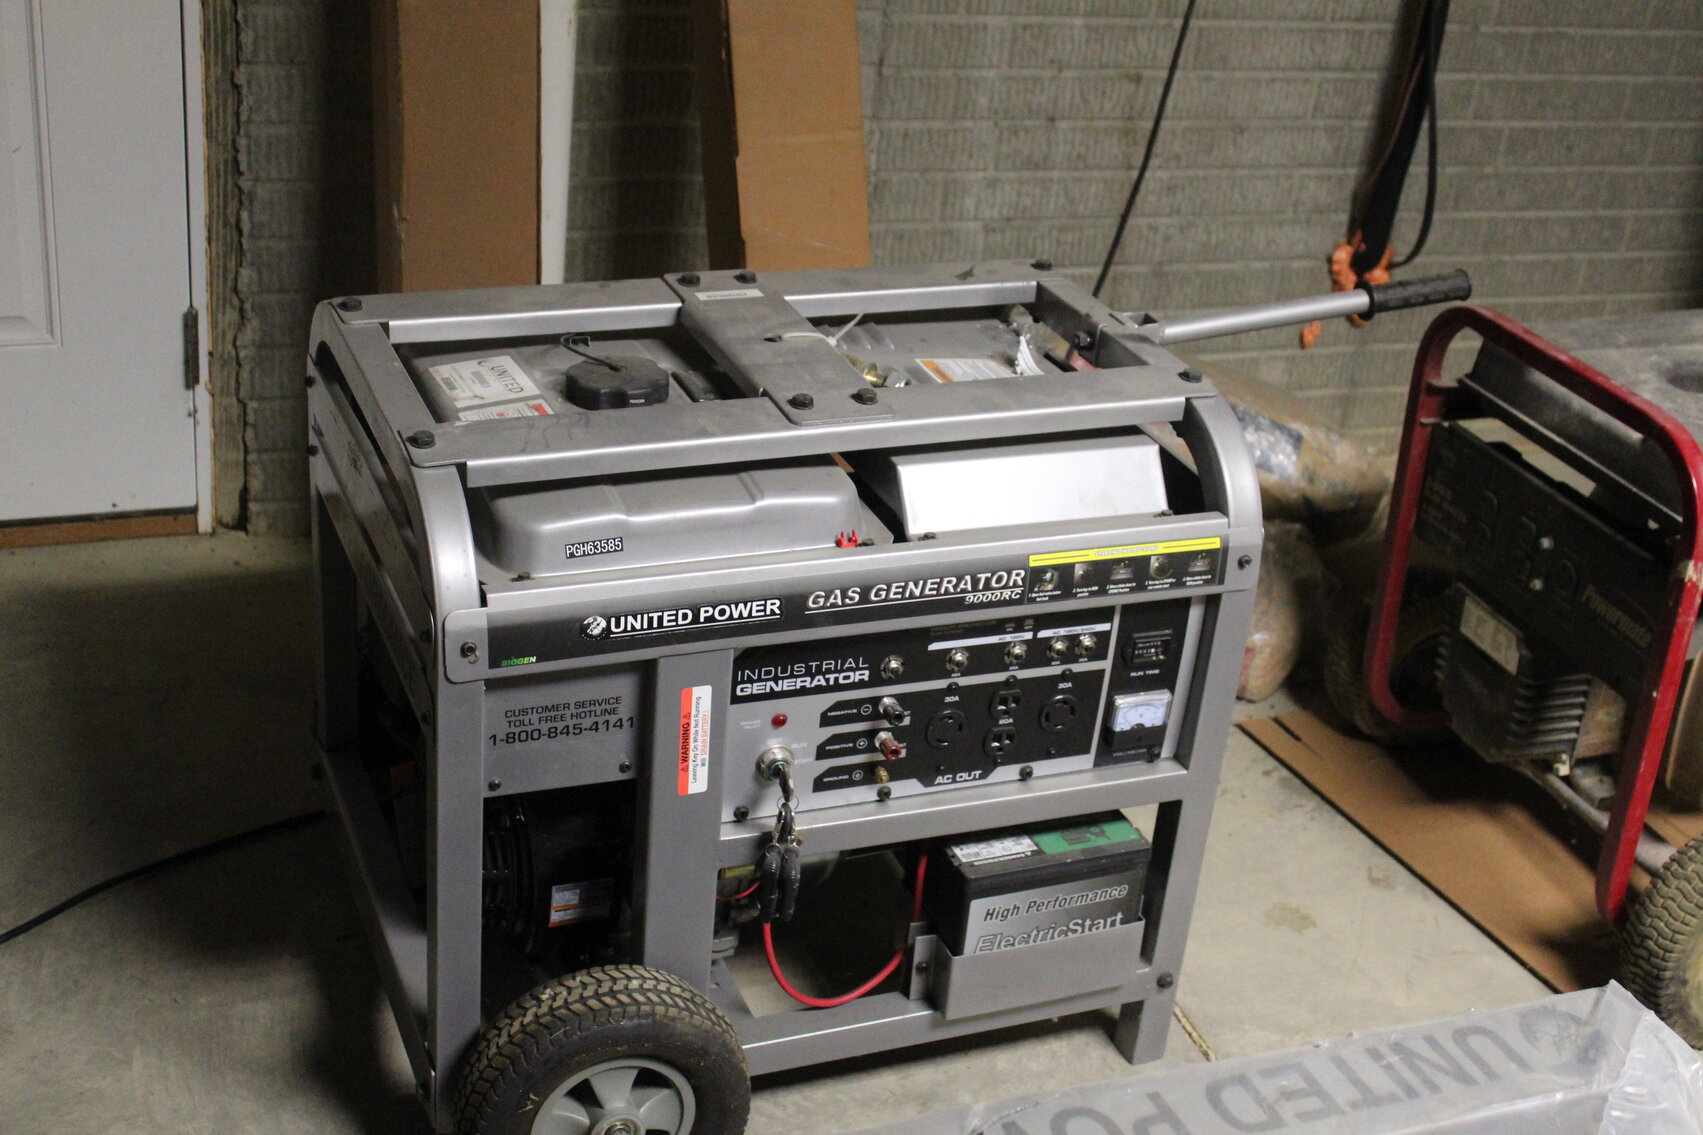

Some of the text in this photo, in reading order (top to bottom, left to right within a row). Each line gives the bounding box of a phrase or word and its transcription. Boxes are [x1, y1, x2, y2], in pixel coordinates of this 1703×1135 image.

[490, 365, 524, 394] UNITED
[566, 539, 622, 557] PGH63585
[807, 570, 1026, 609] GAS GENERATOR
[965, 590, 1022, 605] 9000RC
[610, 599, 781, 633] UNITED POWER
[501, 656, 536, 668] BIOGEN
[737, 657, 869, 682] INDUSTRIAL
[736, 671, 869, 696] GENERATOR
[1057, 681, 1073, 689] 30A
[504, 696, 622, 719] CUSTOMER SERVICE
[694, 696, 702, 718] Running
[944, 695, 960, 703] 30A
[507, 706, 620, 729] TOLL FREE HOTLINE
[827, 708, 858, 717] NEGATIVE
[489, 717, 635, 747] 1-800-845-4141
[681, 722, 690, 764] WARNING
[691, 763, 699, 784] Leaving
[823, 774, 850, 782] GROUND
[934, 769, 983, 785] AC OUT
[983, 884, 1129, 922] High Performance
[974, 911, 1124, 954] ElectricStart
[1205, 1024, 1526, 1134] UNITED
